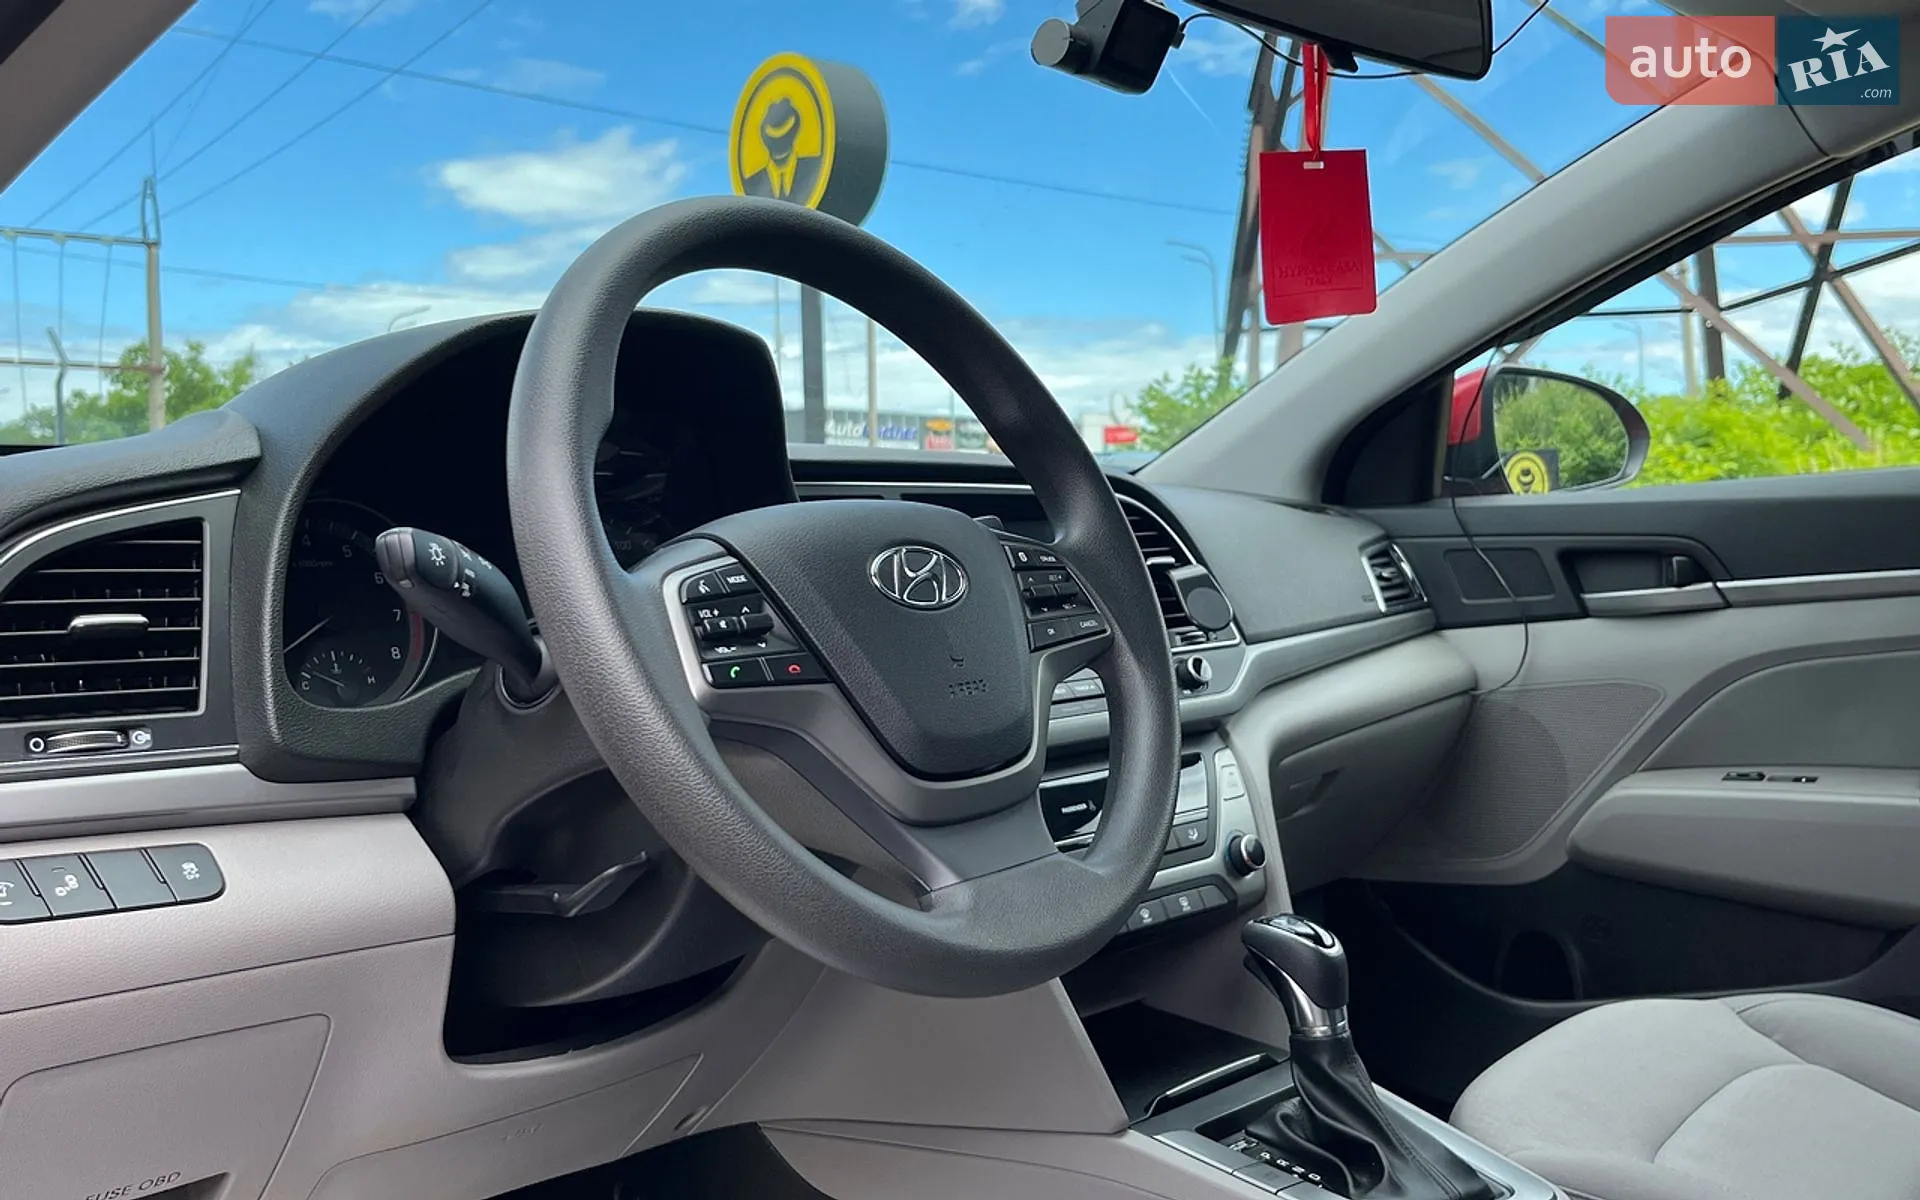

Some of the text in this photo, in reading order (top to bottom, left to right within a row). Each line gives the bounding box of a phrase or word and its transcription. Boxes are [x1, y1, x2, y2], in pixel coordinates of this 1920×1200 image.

[341, 544, 353, 558] 5
[373, 572, 385, 585] 6
[726, 574, 748, 584] MODE
[391, 608, 402, 622] 7
[390, 646, 402, 660] 8
[1260, 1152, 1271, 1160] P
[138, 1171, 181, 1191] OBD
